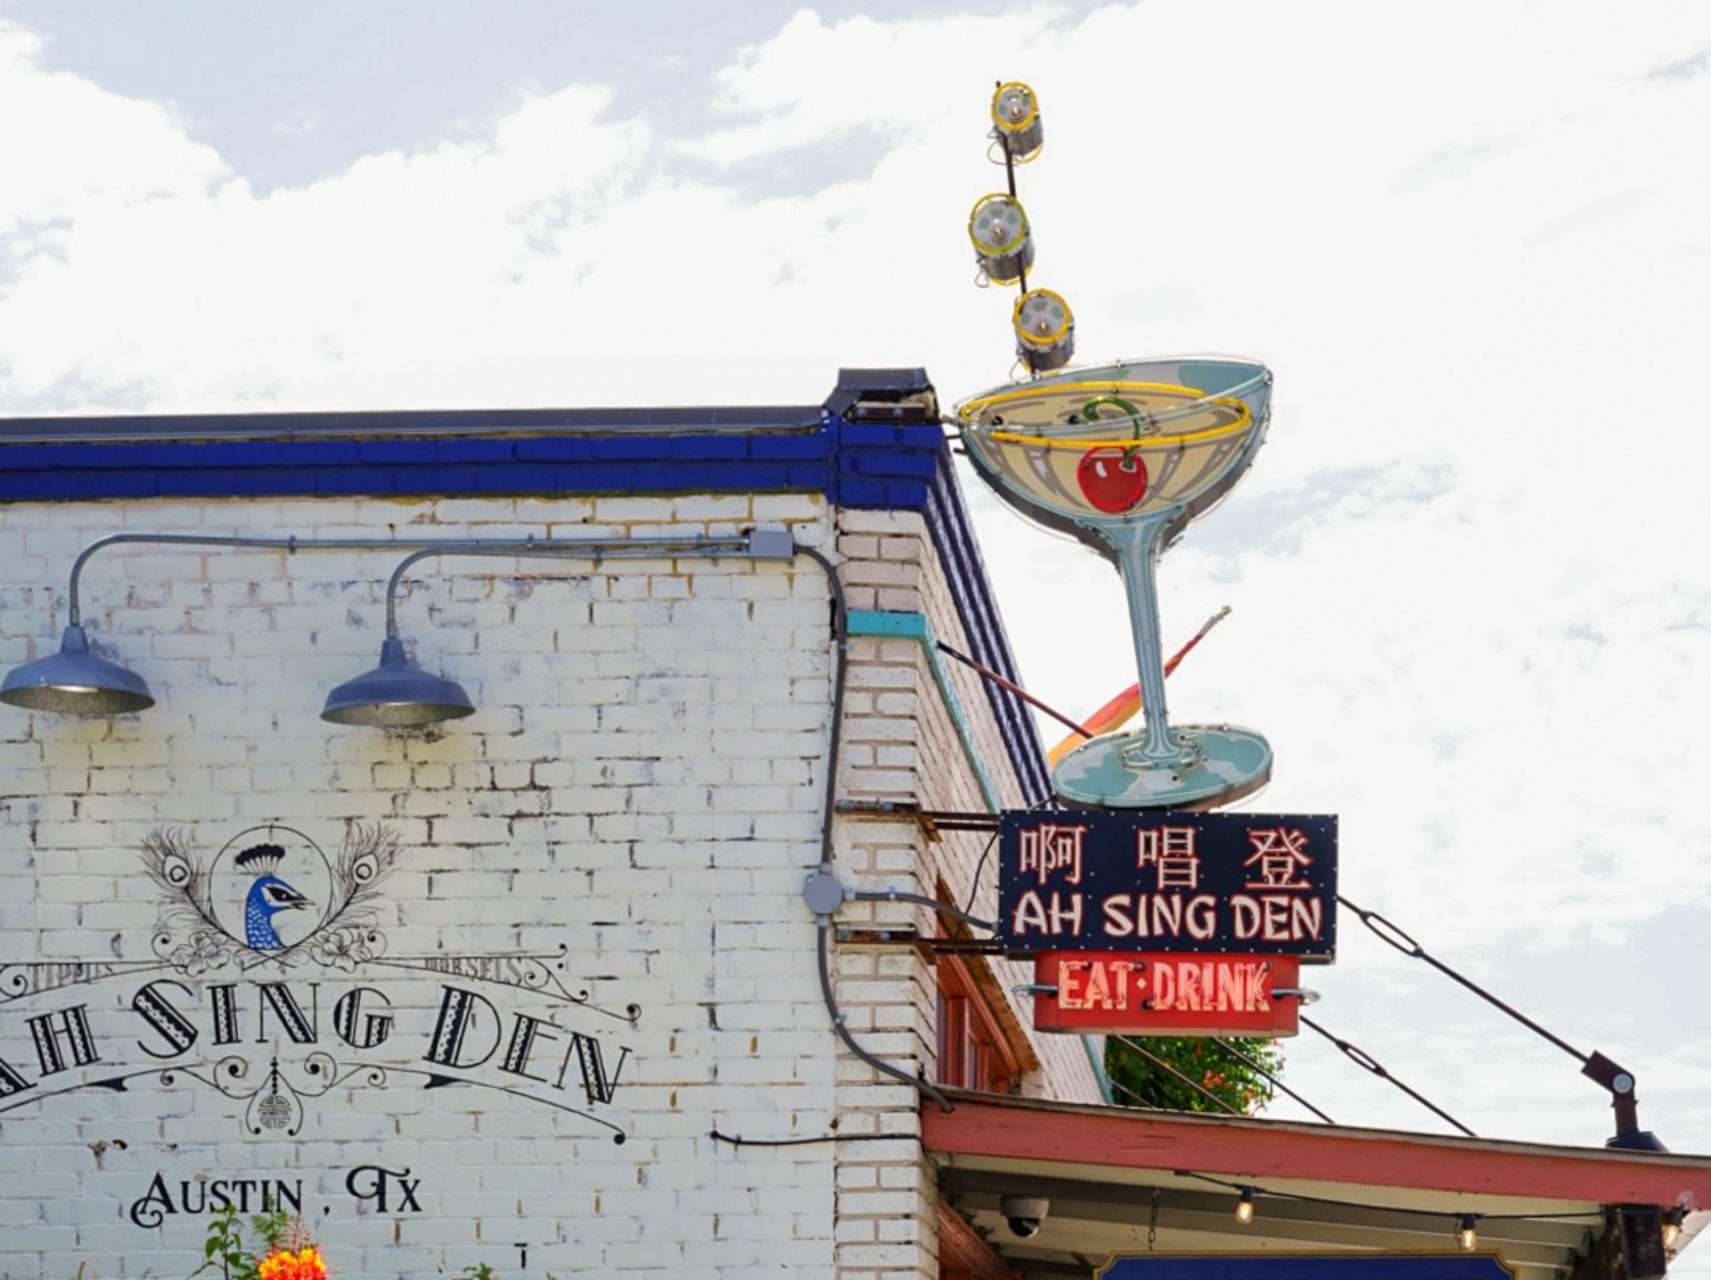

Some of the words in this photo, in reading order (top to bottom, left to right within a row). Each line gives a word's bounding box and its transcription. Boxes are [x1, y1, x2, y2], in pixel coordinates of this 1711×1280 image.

[1013, 891, 1084, 936] AH
[1103, 894, 1216, 939] SING
[1230, 897, 1323, 941] DEN
[0, 1003, 102, 1098] H
[132, 979, 392, 1059] SING
[422, 985, 633, 1104] DEN
